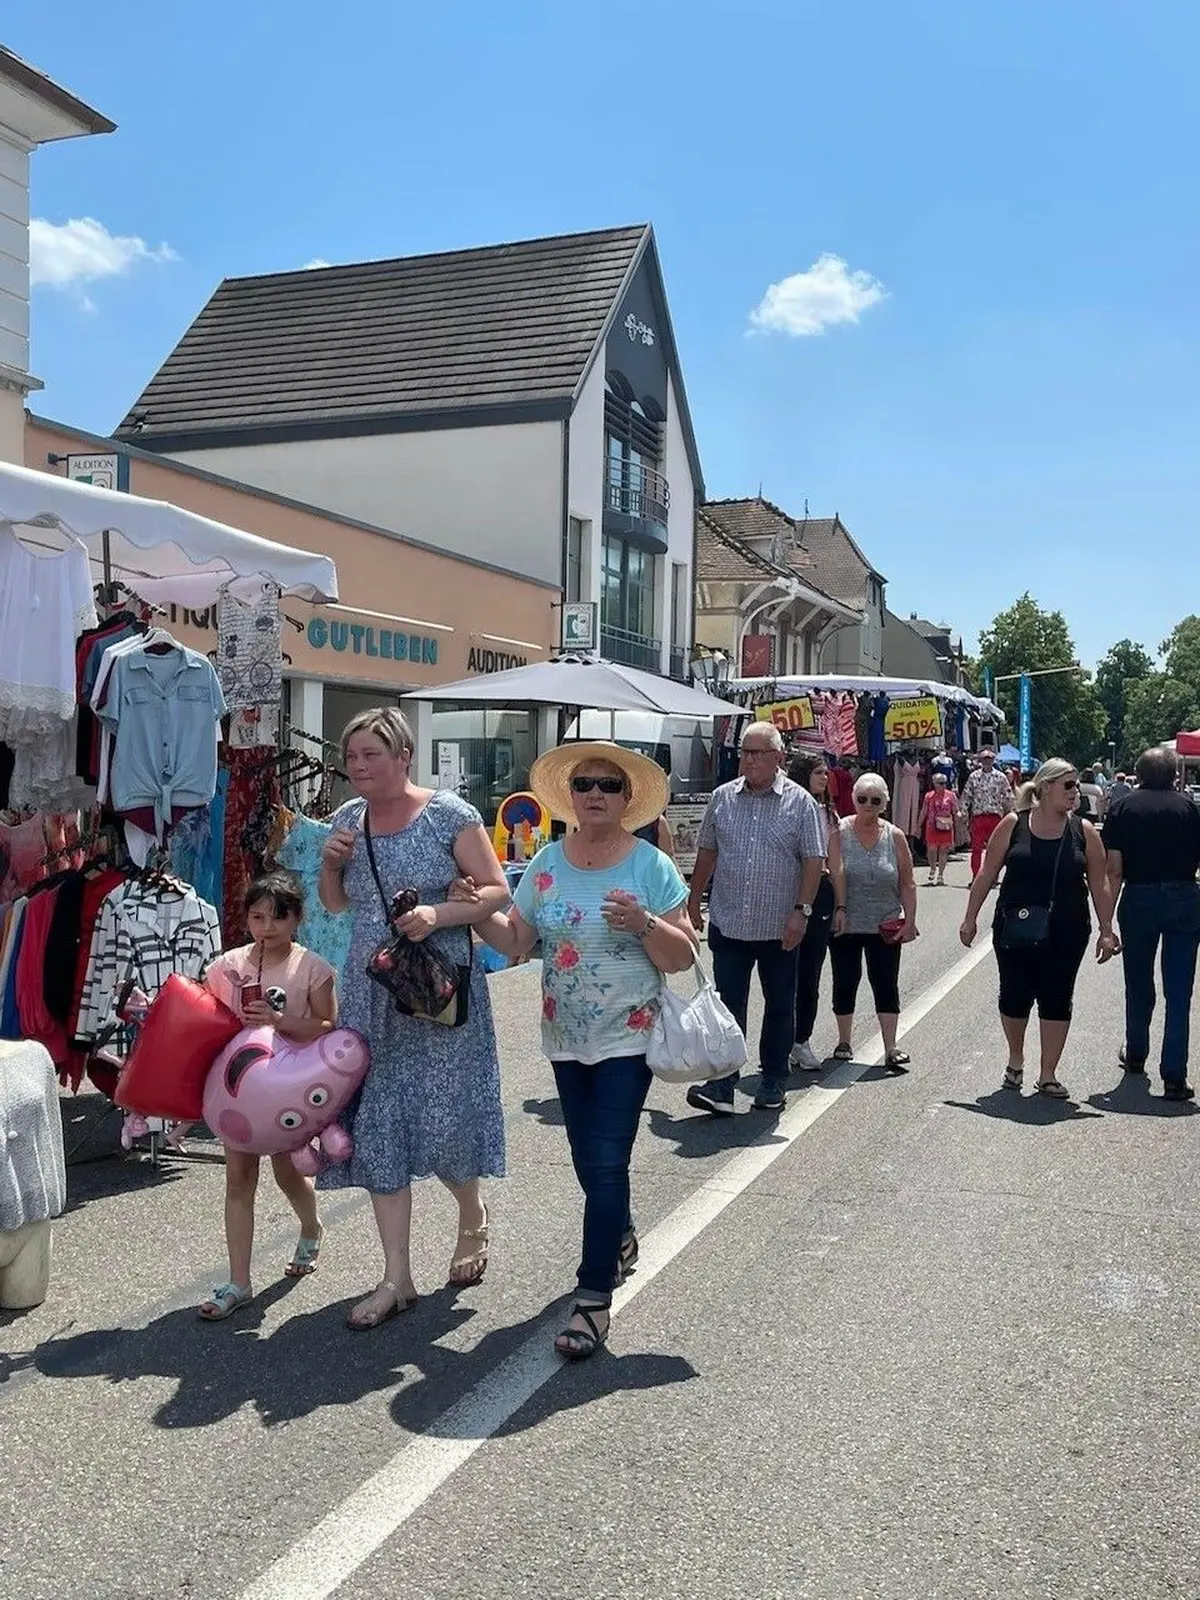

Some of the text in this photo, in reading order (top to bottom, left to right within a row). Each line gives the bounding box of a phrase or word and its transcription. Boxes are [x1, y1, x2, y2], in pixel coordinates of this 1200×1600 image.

[73, 460, 113, 469] AUDITION
[307, 618, 438, 665] GUTLEBEN
[890, 700, 934, 709] QUIDATION
